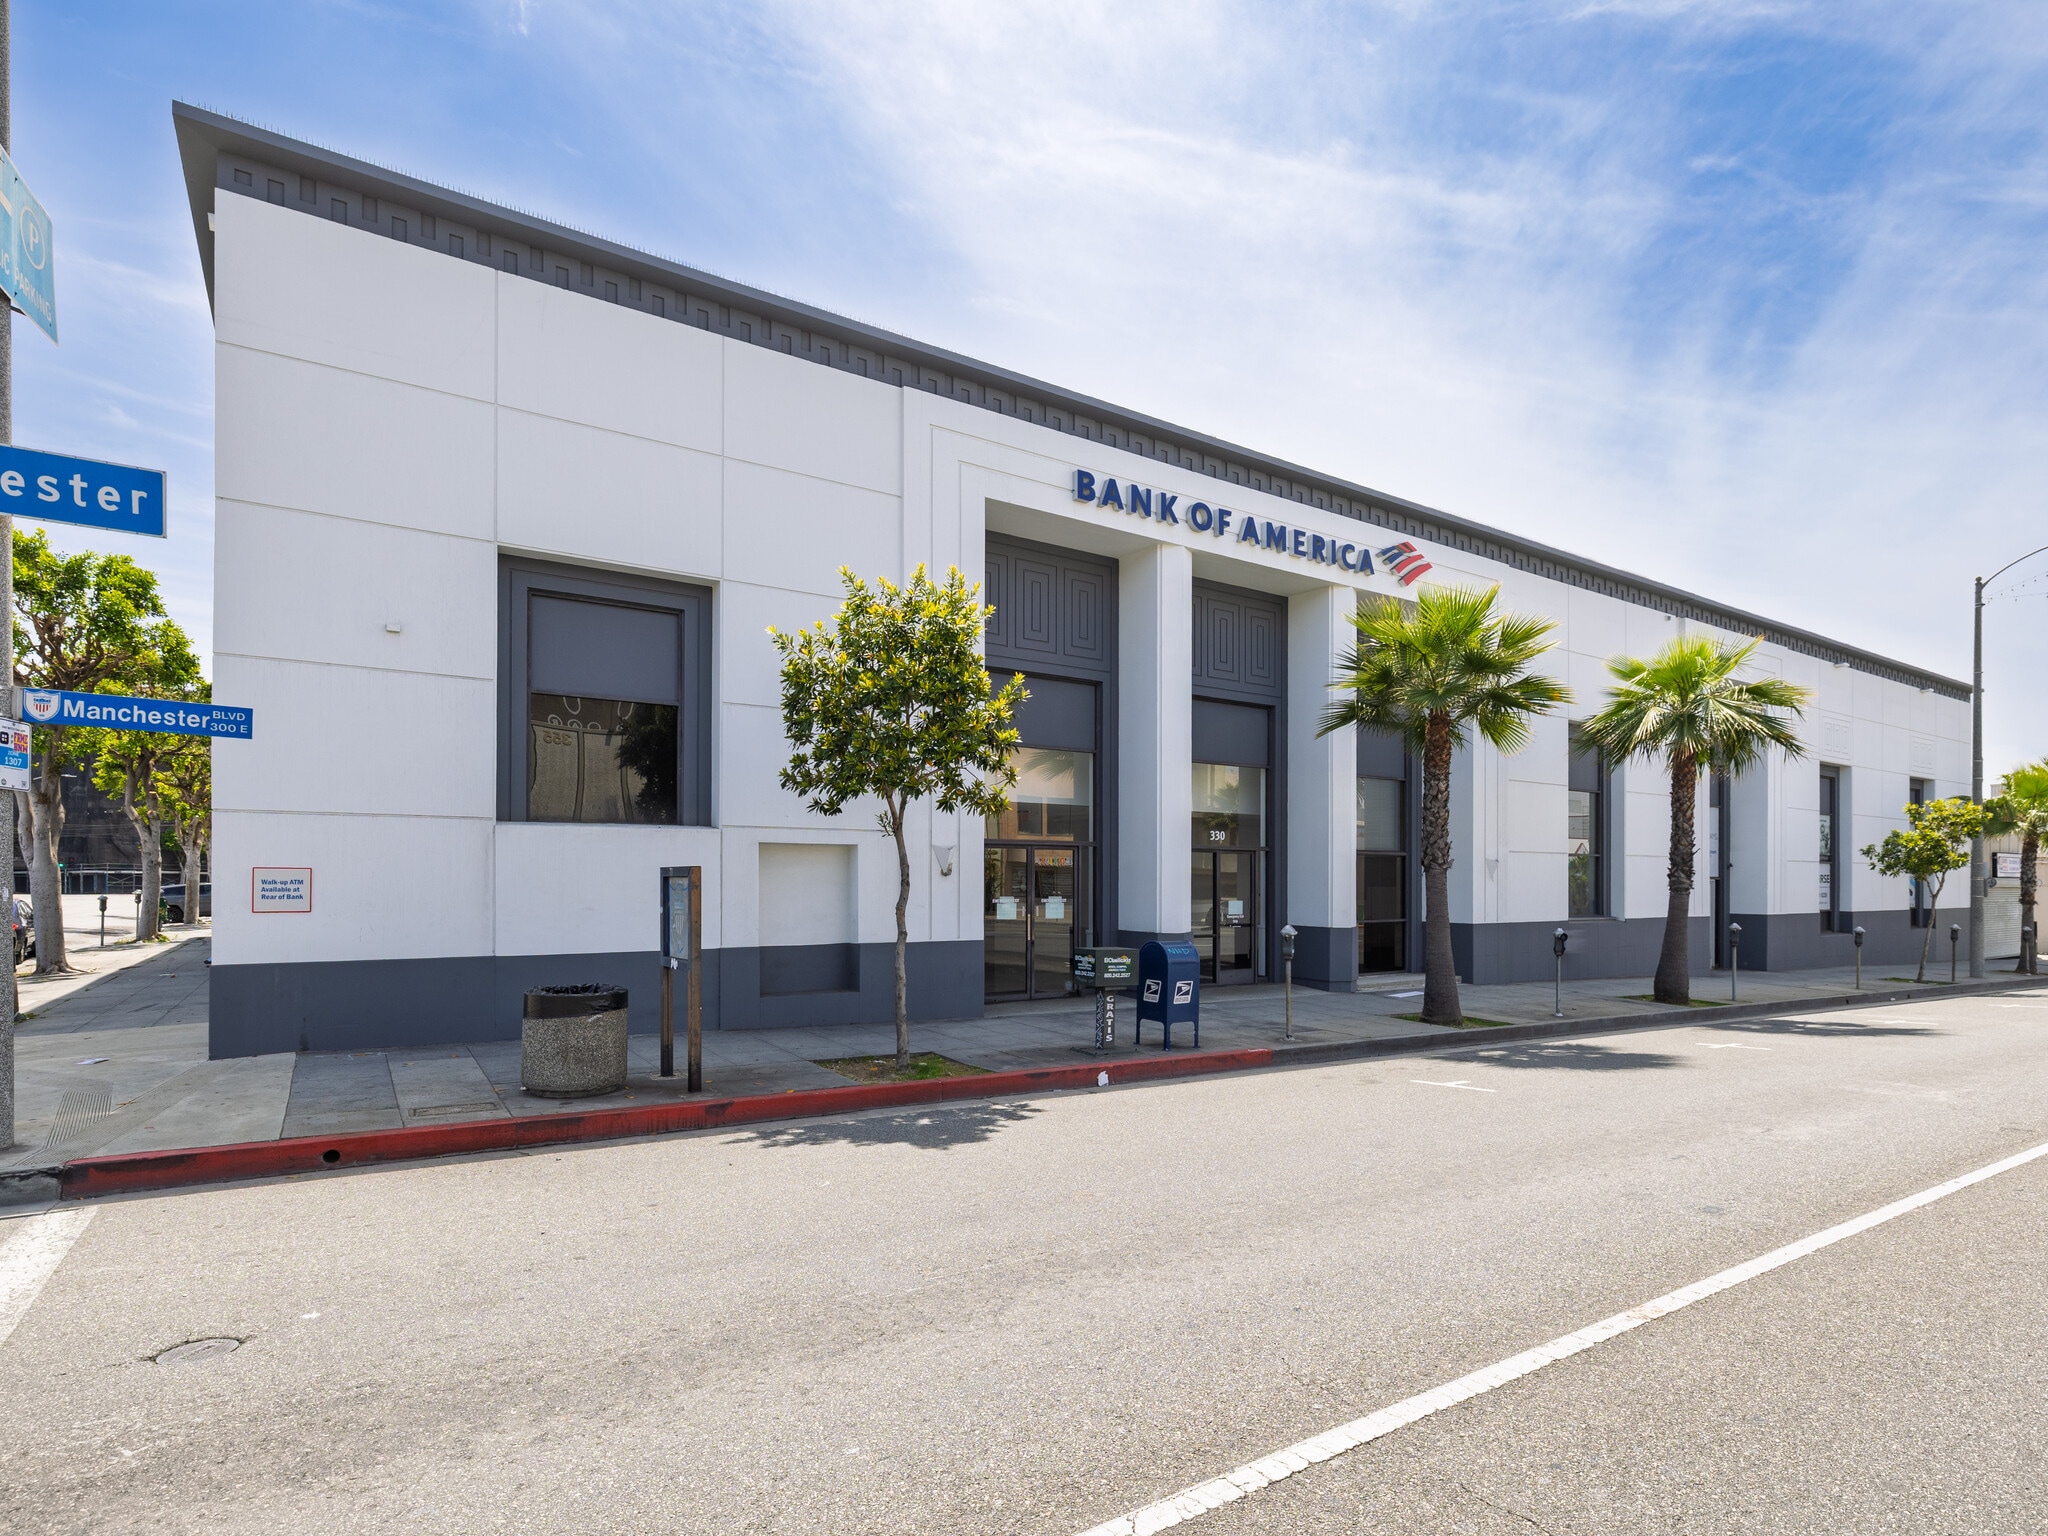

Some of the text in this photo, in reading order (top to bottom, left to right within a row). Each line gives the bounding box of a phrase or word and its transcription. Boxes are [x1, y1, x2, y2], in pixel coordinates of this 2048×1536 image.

[14, 266, 52, 323] PARKING
[0, 470, 148, 515] ester
[1073, 469, 1375, 576] BANK OF AMERICA
[63, 699, 246, 729] Manchester BLVD
[210, 722, 248, 733] 300 E
[5, 756, 22, 766] 1307
[1210, 831, 1225, 840] 330
[1105, 995, 1115, 1042] GRATIS
